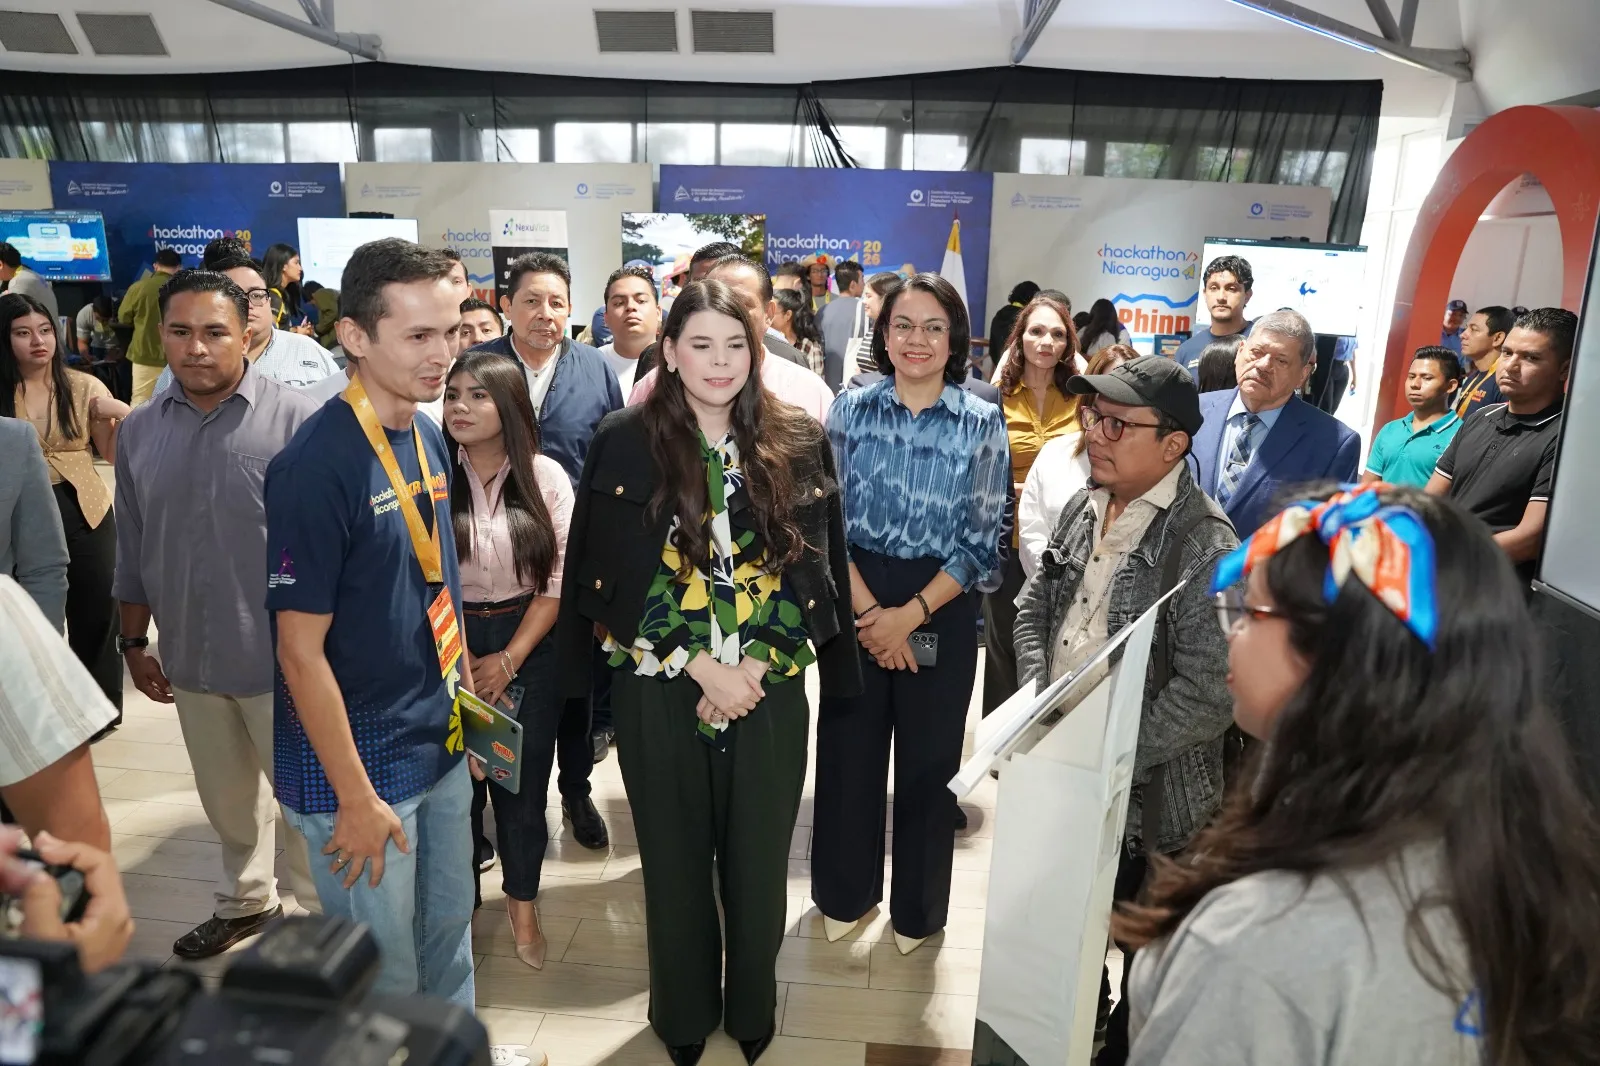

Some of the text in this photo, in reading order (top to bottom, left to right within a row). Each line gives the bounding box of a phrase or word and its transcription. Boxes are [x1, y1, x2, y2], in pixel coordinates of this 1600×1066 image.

[863, 240, 881, 253] 20
[863, 253, 881, 266] 26
[1102, 260, 1180, 281] Nicaragua
